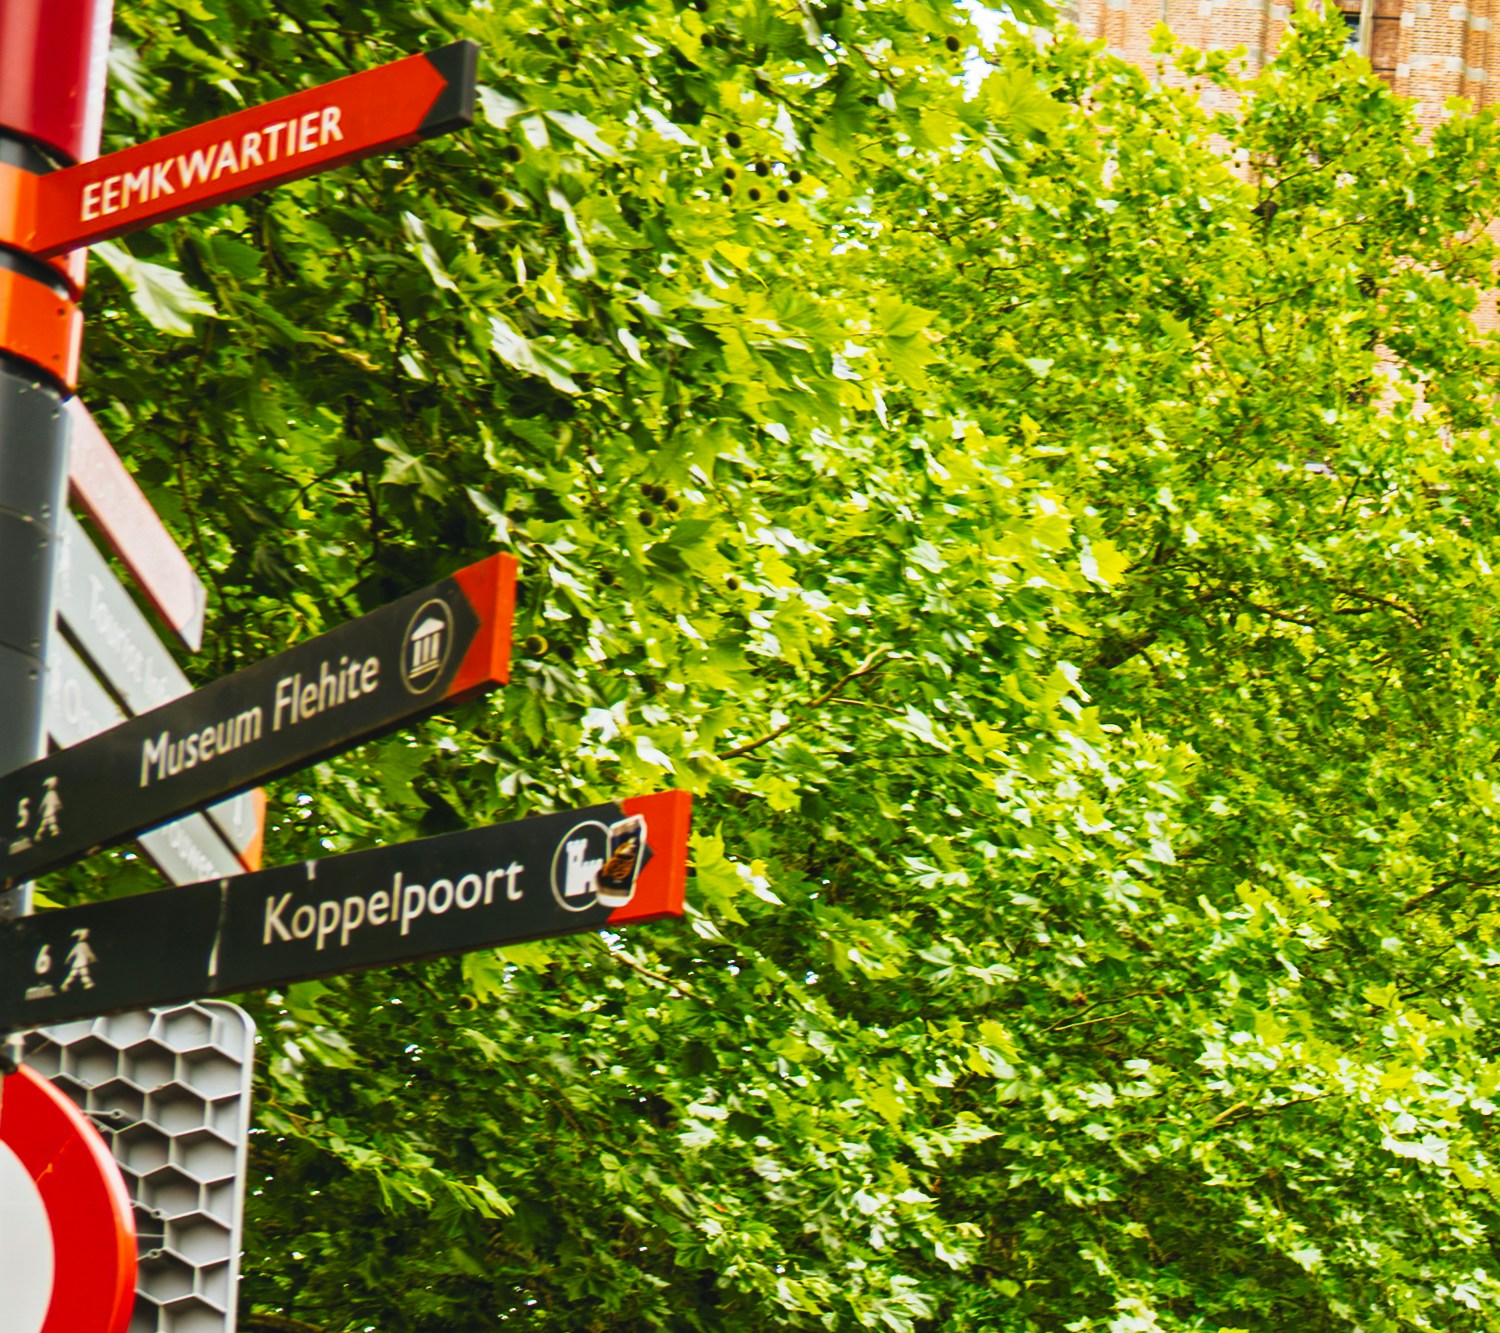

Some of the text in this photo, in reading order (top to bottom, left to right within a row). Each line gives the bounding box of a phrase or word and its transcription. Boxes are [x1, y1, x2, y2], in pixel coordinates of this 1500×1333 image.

[80, 105, 345, 222] EEMKWARTIER
[139, 705, 263, 788] Museum
[271, 655, 381, 732] Flehite
[16, 797, 31, 829] 5
[262, 860, 526, 951] Koppelpoort
[35, 943, 51, 975] 6
